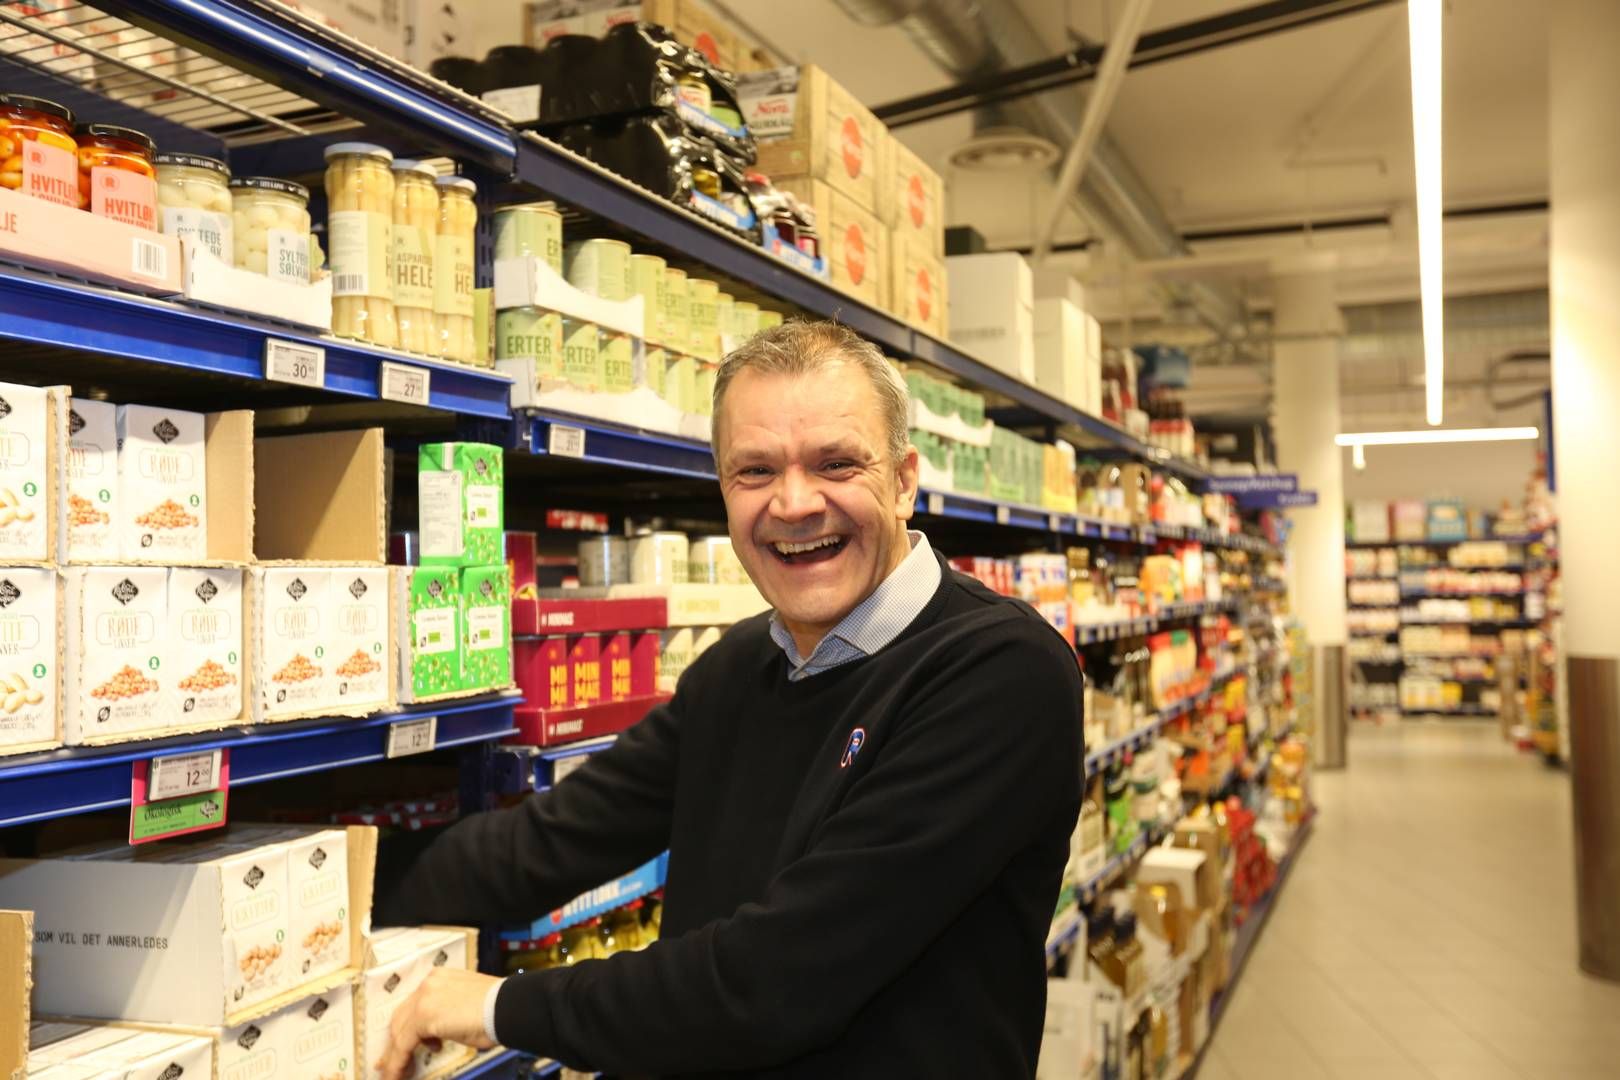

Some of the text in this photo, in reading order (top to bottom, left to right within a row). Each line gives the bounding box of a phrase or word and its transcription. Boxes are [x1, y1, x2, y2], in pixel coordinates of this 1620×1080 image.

[506, 336, 552, 355] ERTER
[293, 363, 307, 378] 30
[404, 383, 416, 398] 27
[187, 770, 200, 787] 12
[35, 932, 168, 949] SOM VIL DET ANNERLEDES
